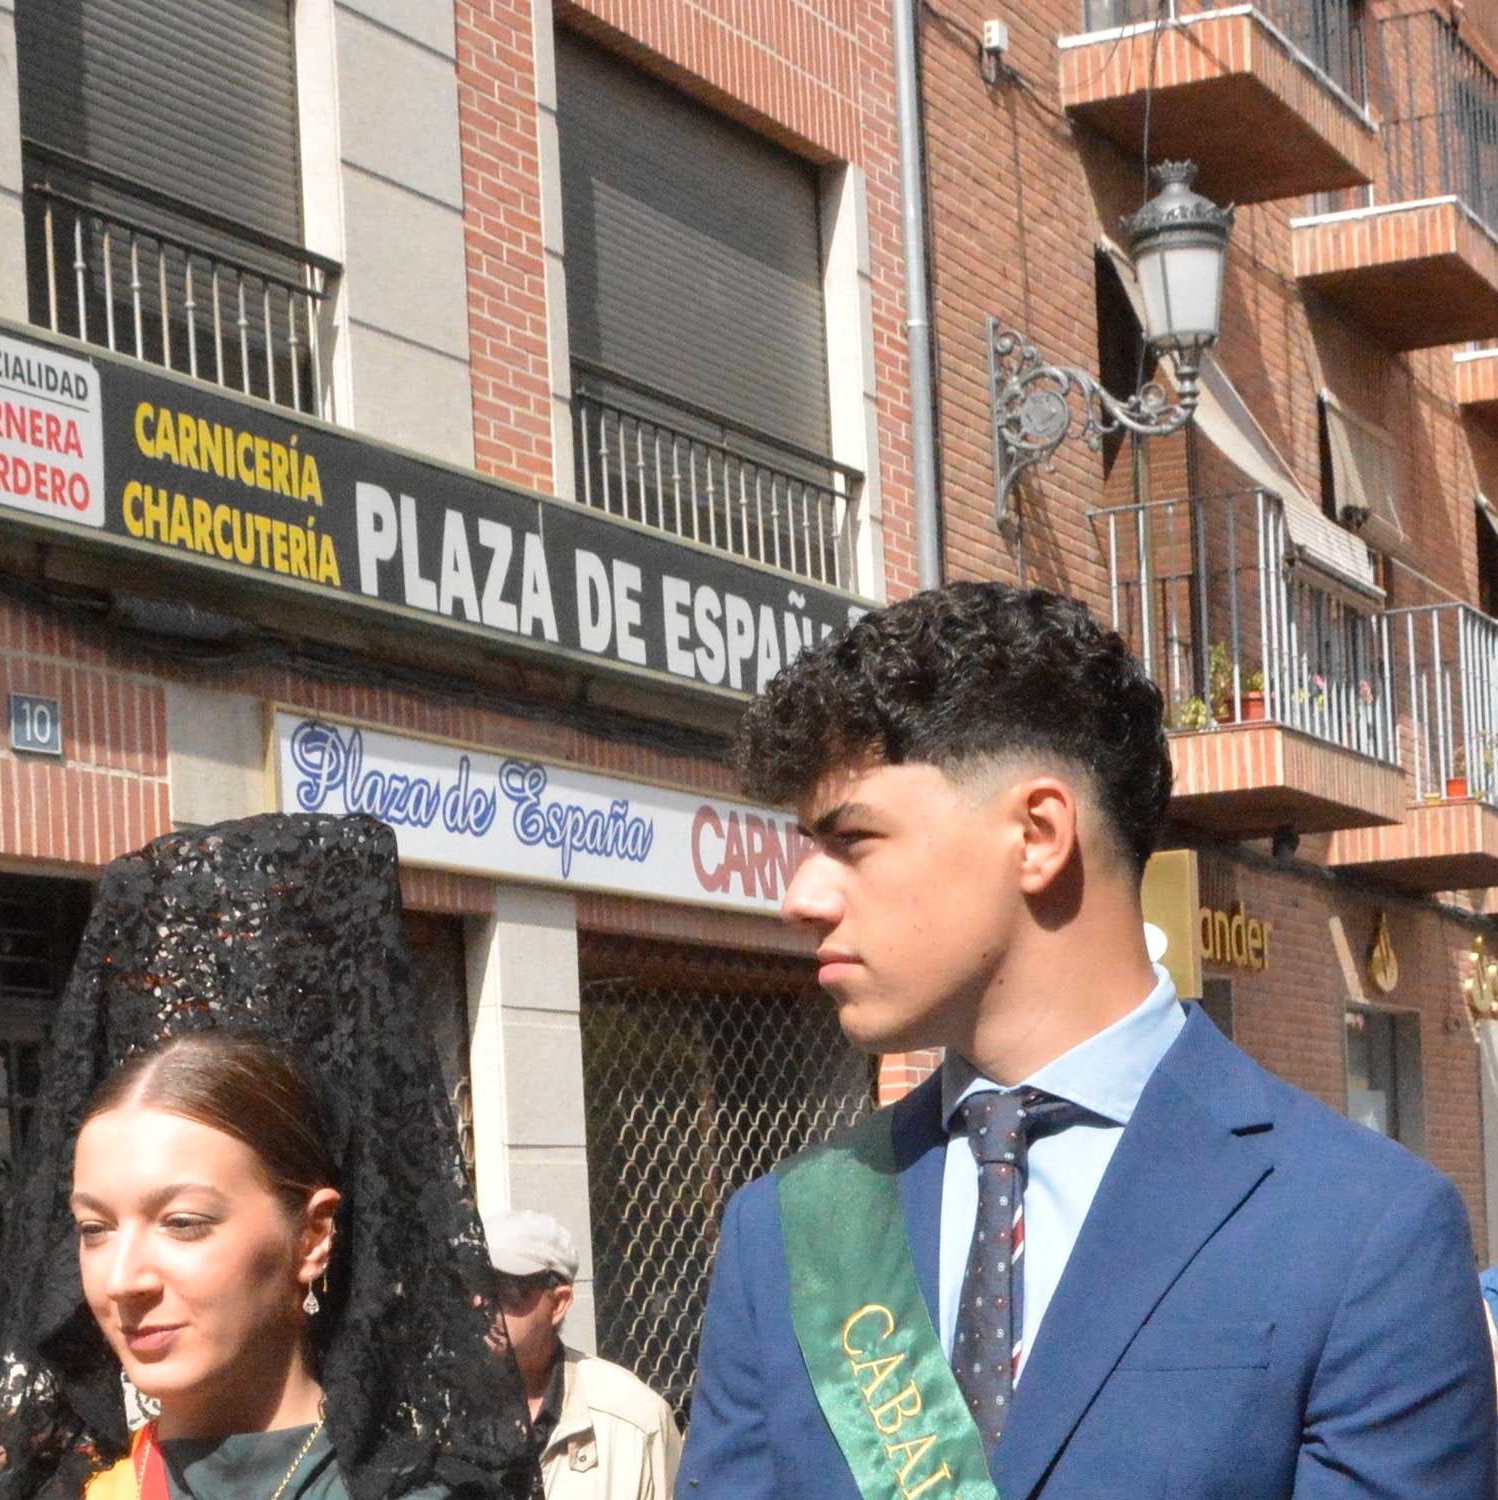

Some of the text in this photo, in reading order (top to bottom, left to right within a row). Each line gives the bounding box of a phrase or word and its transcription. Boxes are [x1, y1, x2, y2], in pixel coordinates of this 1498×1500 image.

[134, 401, 324, 507] CARNICERÍA
[122, 480, 341, 587] CHARCUTERÍA
[355, 481, 833, 696] PLAZA DE ESPAÑ
[22, 702, 51, 743] 10
[291, 720, 654, 879] Plaza de España
[1199, 900, 1272, 970] ander
